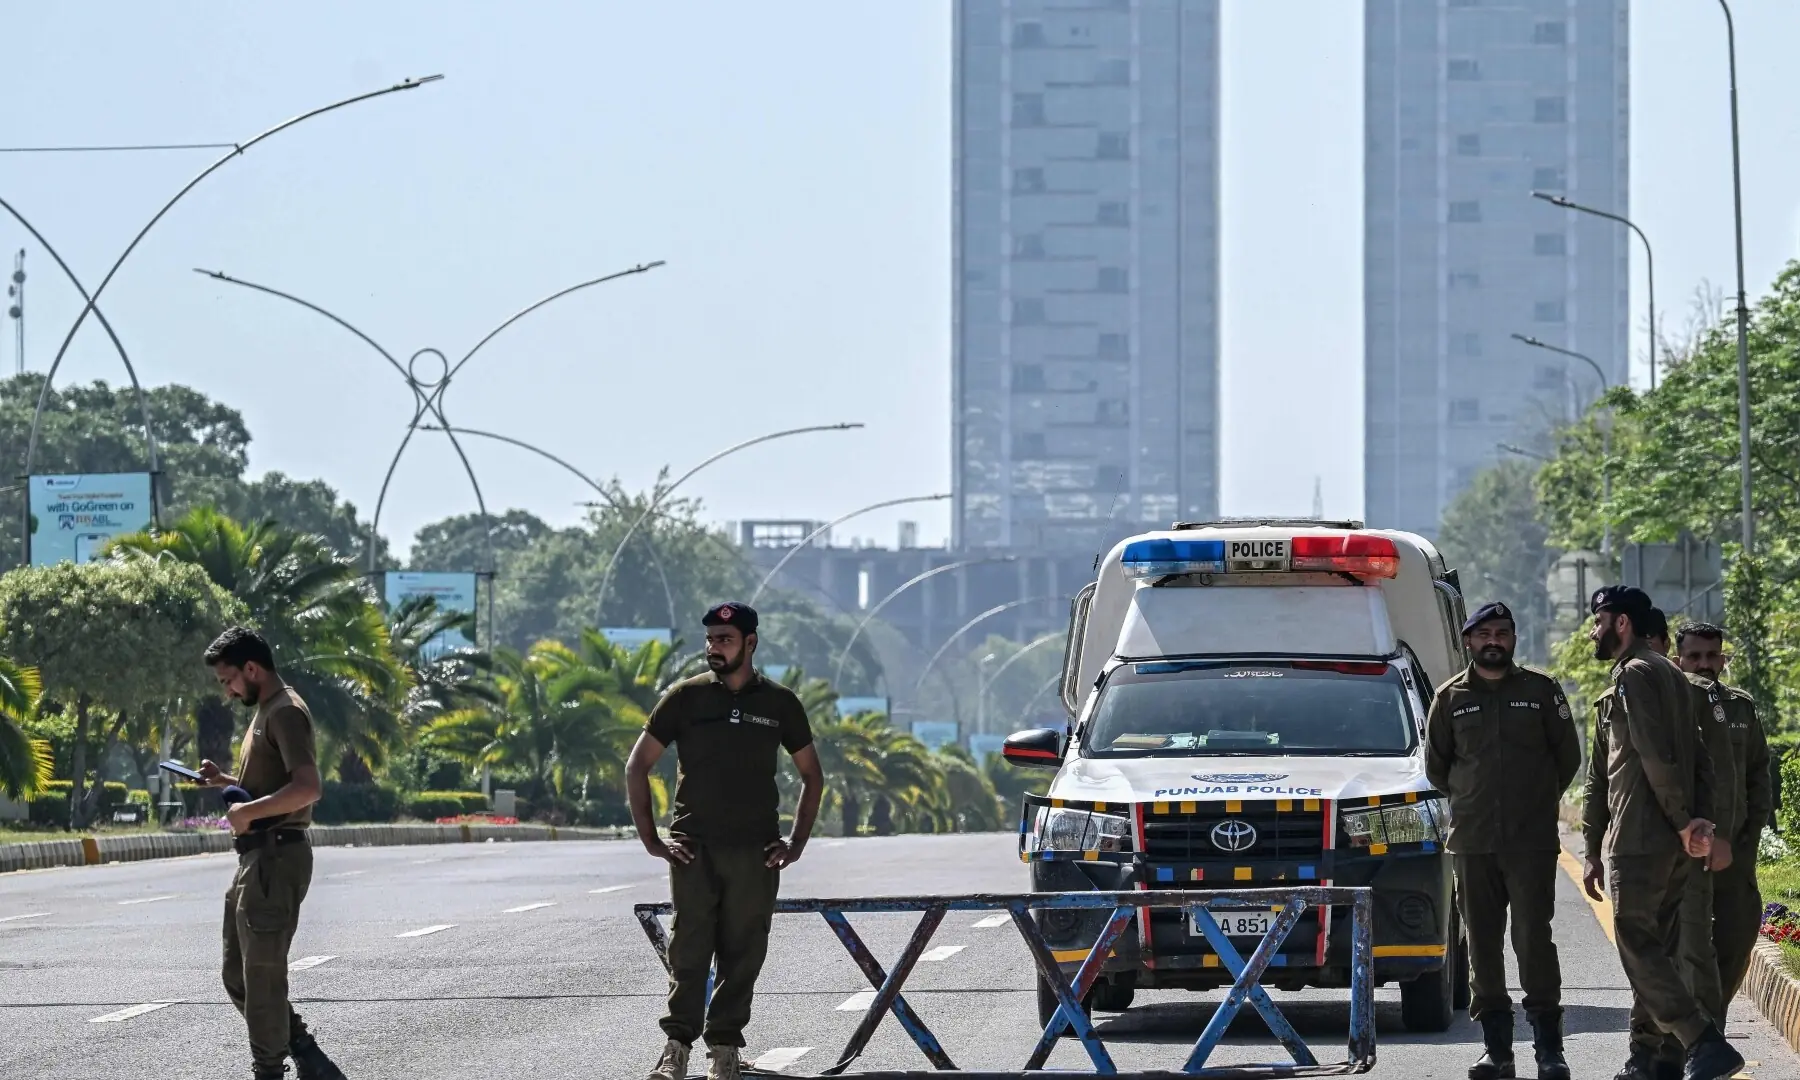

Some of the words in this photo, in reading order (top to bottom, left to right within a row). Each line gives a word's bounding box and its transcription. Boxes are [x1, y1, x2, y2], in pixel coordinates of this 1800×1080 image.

[47, 501, 69, 513] with
[72, 500, 118, 513] GoGreen
[120, 502, 134, 511] on
[1232, 541, 1283, 558] POLICE
[752, 716, 770, 726] POLICE
[1154, 785, 1239, 797] PUNJAB
[1246, 785, 1323, 796] POLICE
[1236, 918, 1269, 933] 851
